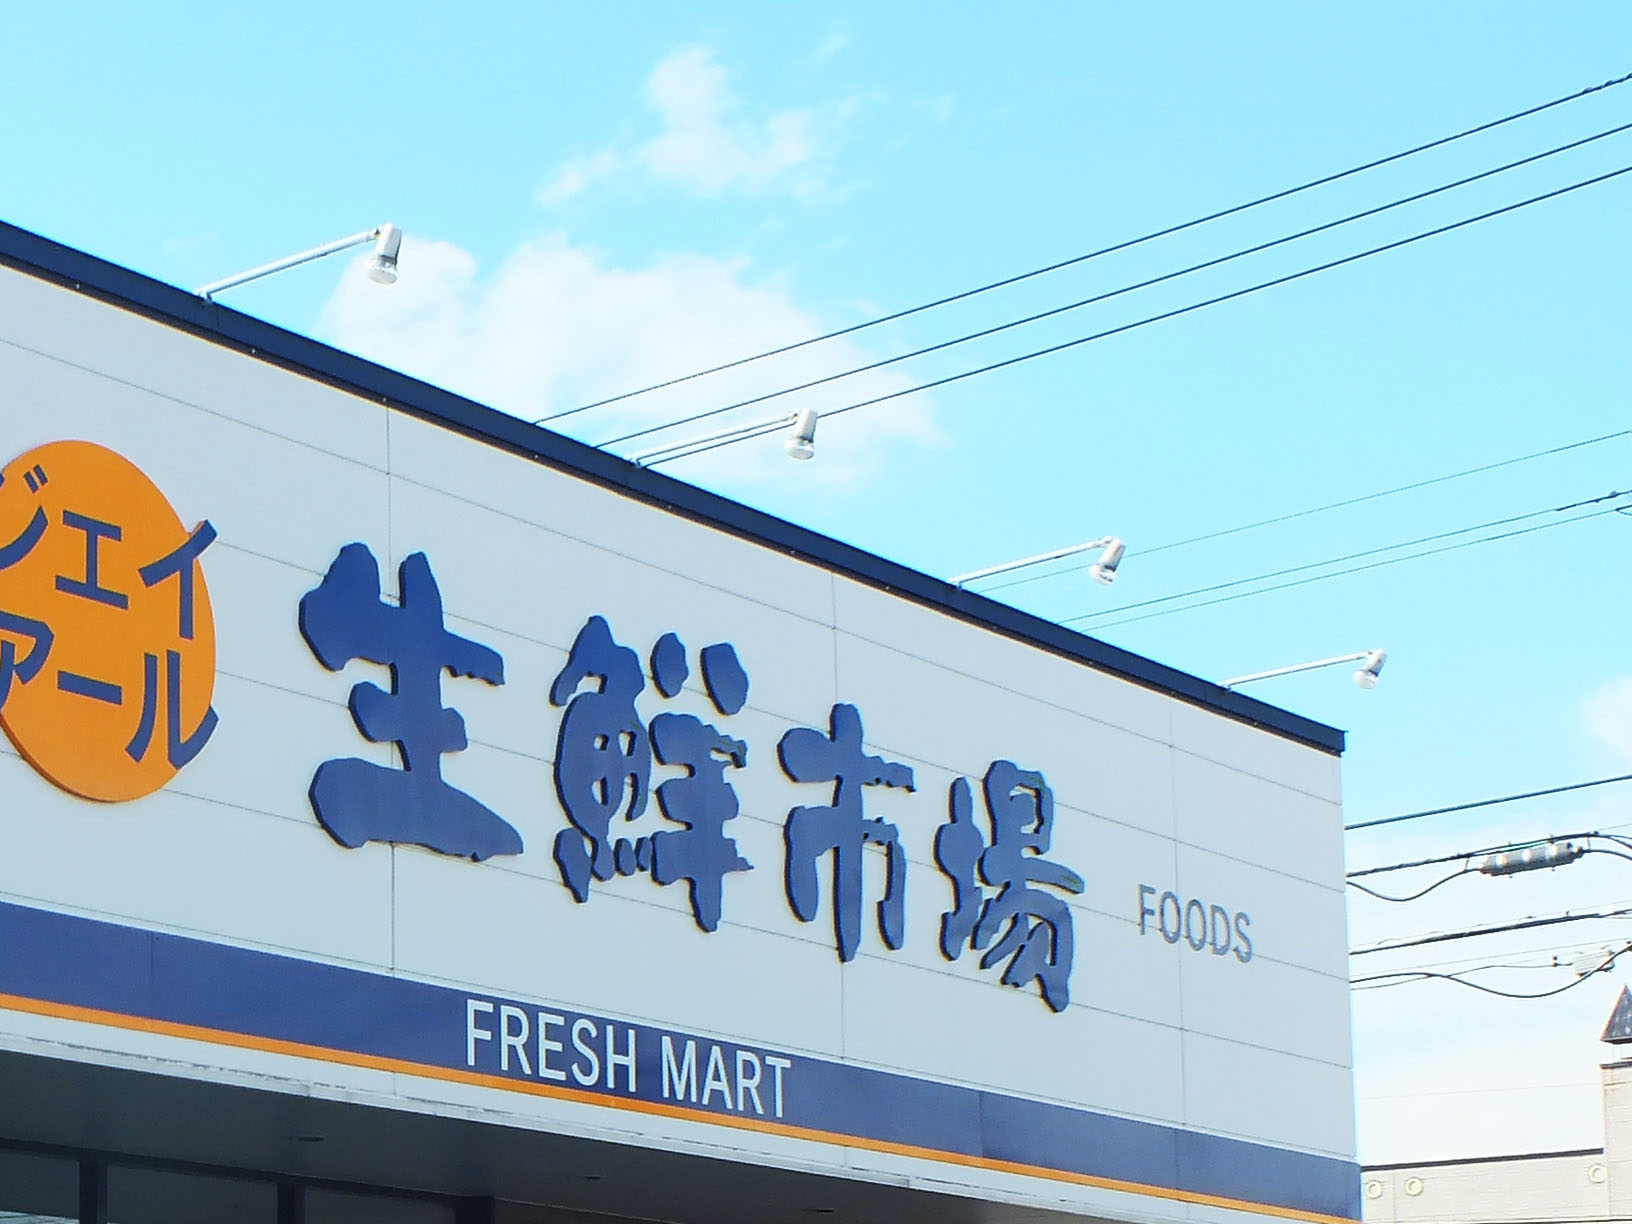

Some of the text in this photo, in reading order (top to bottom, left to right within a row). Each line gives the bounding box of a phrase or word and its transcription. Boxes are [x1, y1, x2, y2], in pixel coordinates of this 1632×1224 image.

[298, 541, 1086, 1014] 生鮮市場
[1137, 883, 1253, 963] FOODS
[465, 998, 792, 1118] FRESH MART
